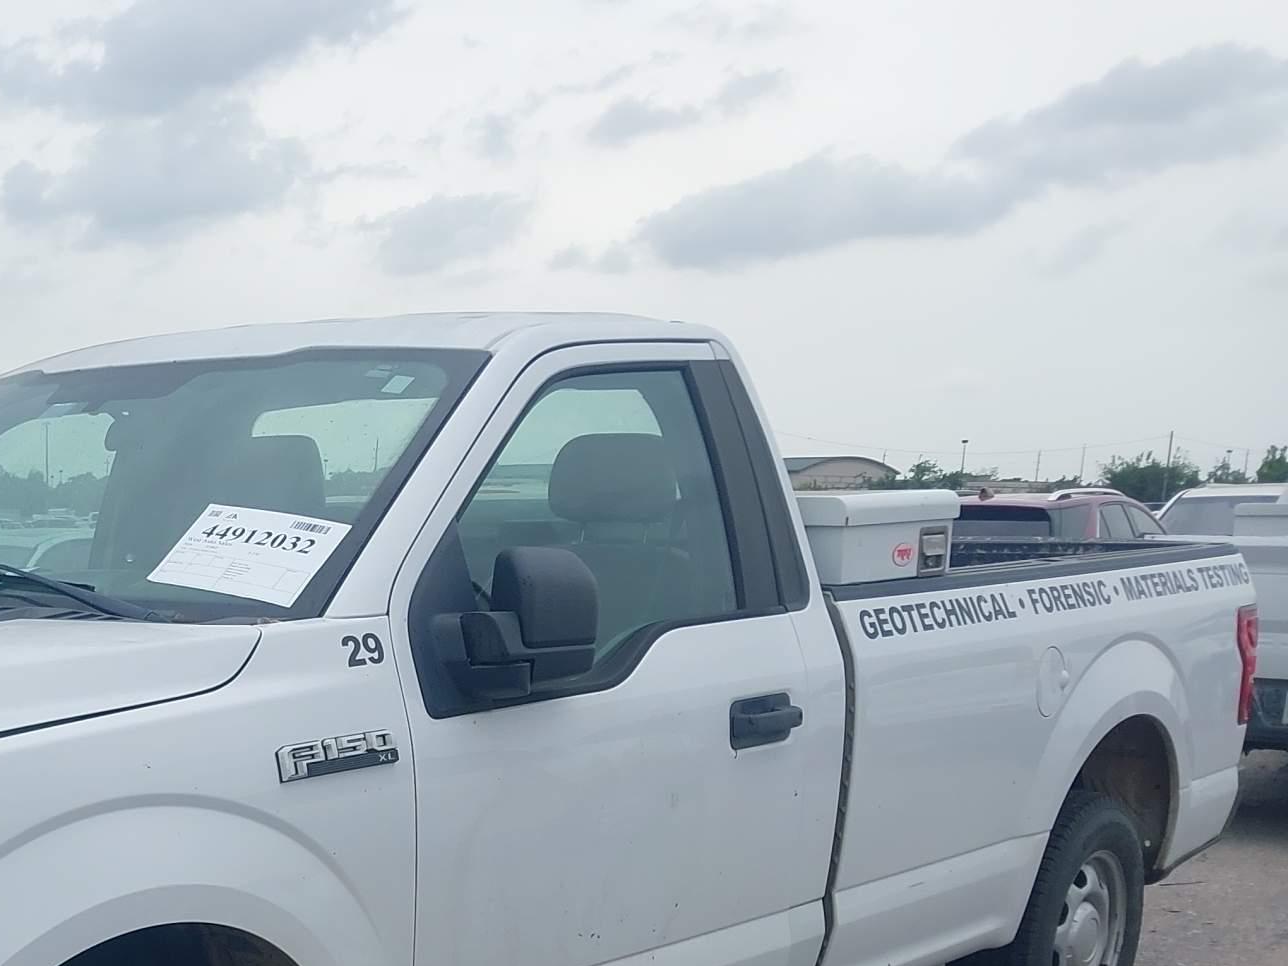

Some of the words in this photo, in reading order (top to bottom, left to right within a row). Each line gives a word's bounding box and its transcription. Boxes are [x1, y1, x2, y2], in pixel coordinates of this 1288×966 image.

[201, 524, 316, 555] 44912032
[859, 592, 1017, 640] GEOTECHNICAL
[1026, 580, 1112, 615] FORENSIC
[1124, 568, 1200, 601] MATERIALS
[1198, 563, 1250, 590] TESTING
[341, 632, 385, 667] 29
[275, 729, 398, 783] F150
[378, 752, 397, 762] XL
